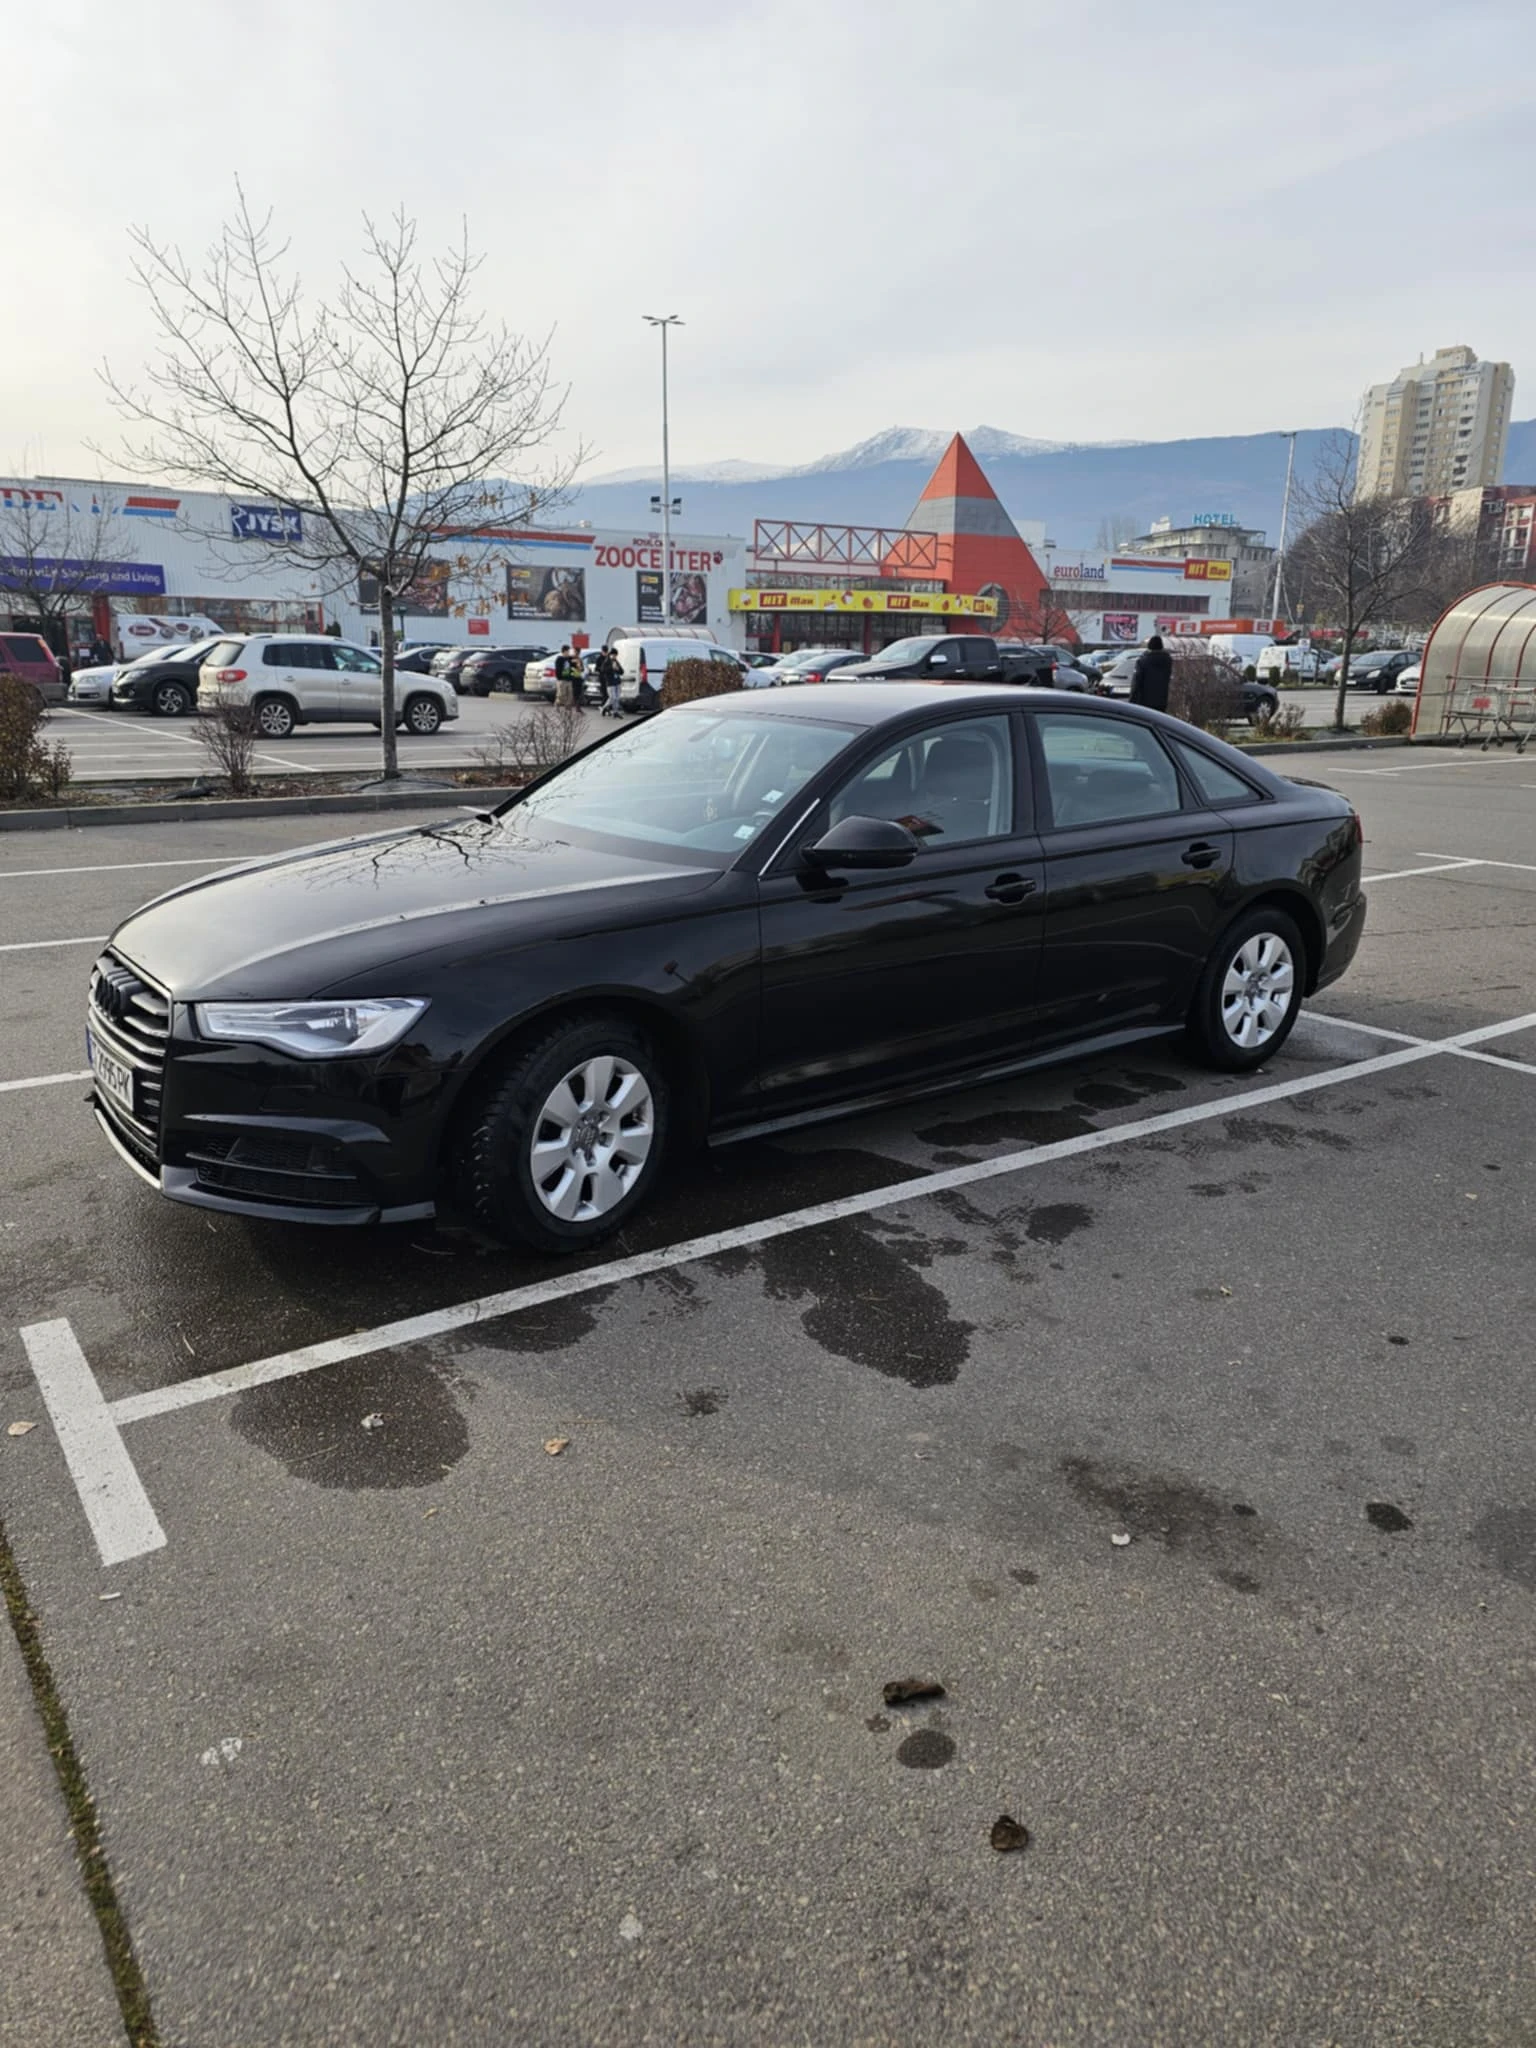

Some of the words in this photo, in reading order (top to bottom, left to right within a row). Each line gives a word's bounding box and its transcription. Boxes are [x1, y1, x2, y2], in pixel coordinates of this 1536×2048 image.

[246, 513, 299, 534] JYSK
[1192, 512, 1239, 525] HOTEL
[1054, 562, 1104, 578] euroland
[1188, 563, 1206, 576] HIT
[61, 568, 109, 582] Sleing
[132, 572, 161, 586] Living
[762, 595, 784, 605] HIT
[889, 597, 910, 607] HIT
